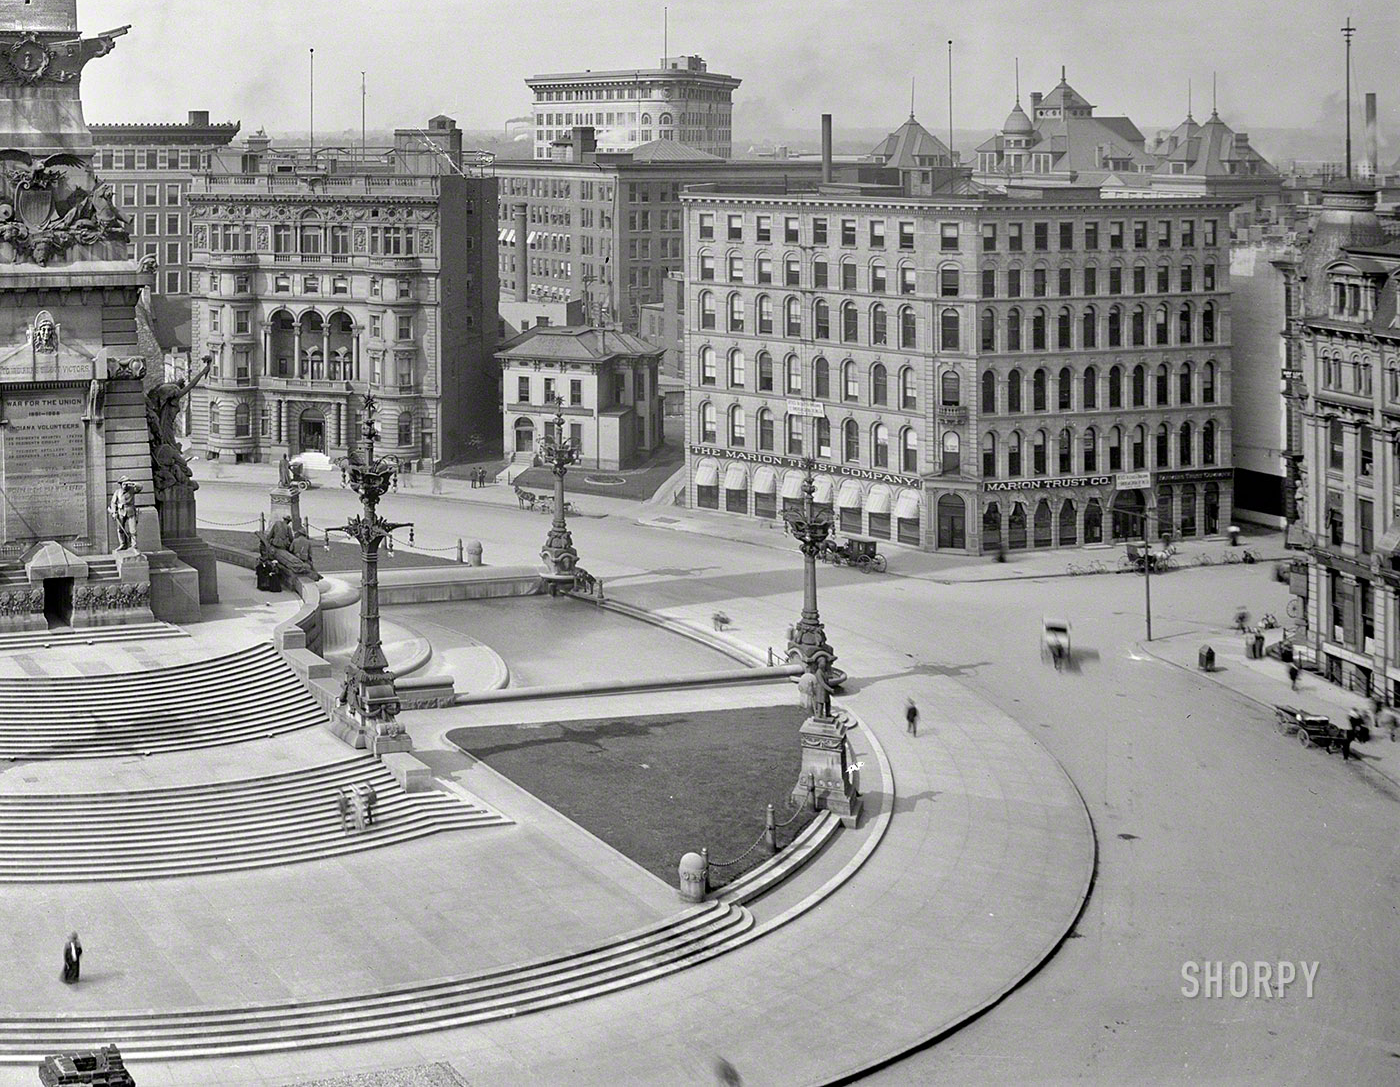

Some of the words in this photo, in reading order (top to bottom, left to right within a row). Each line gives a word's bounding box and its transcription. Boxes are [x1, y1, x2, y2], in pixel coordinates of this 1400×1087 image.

[692, 446, 720, 456] THE
[725, 450, 782, 465] MARION
[841, 467, 918, 487] COMPANY.
[987, 481, 1040, 491] MARION
[1044, 478, 1087, 488] TRUST
[1090, 476, 1111, 485] CO.
